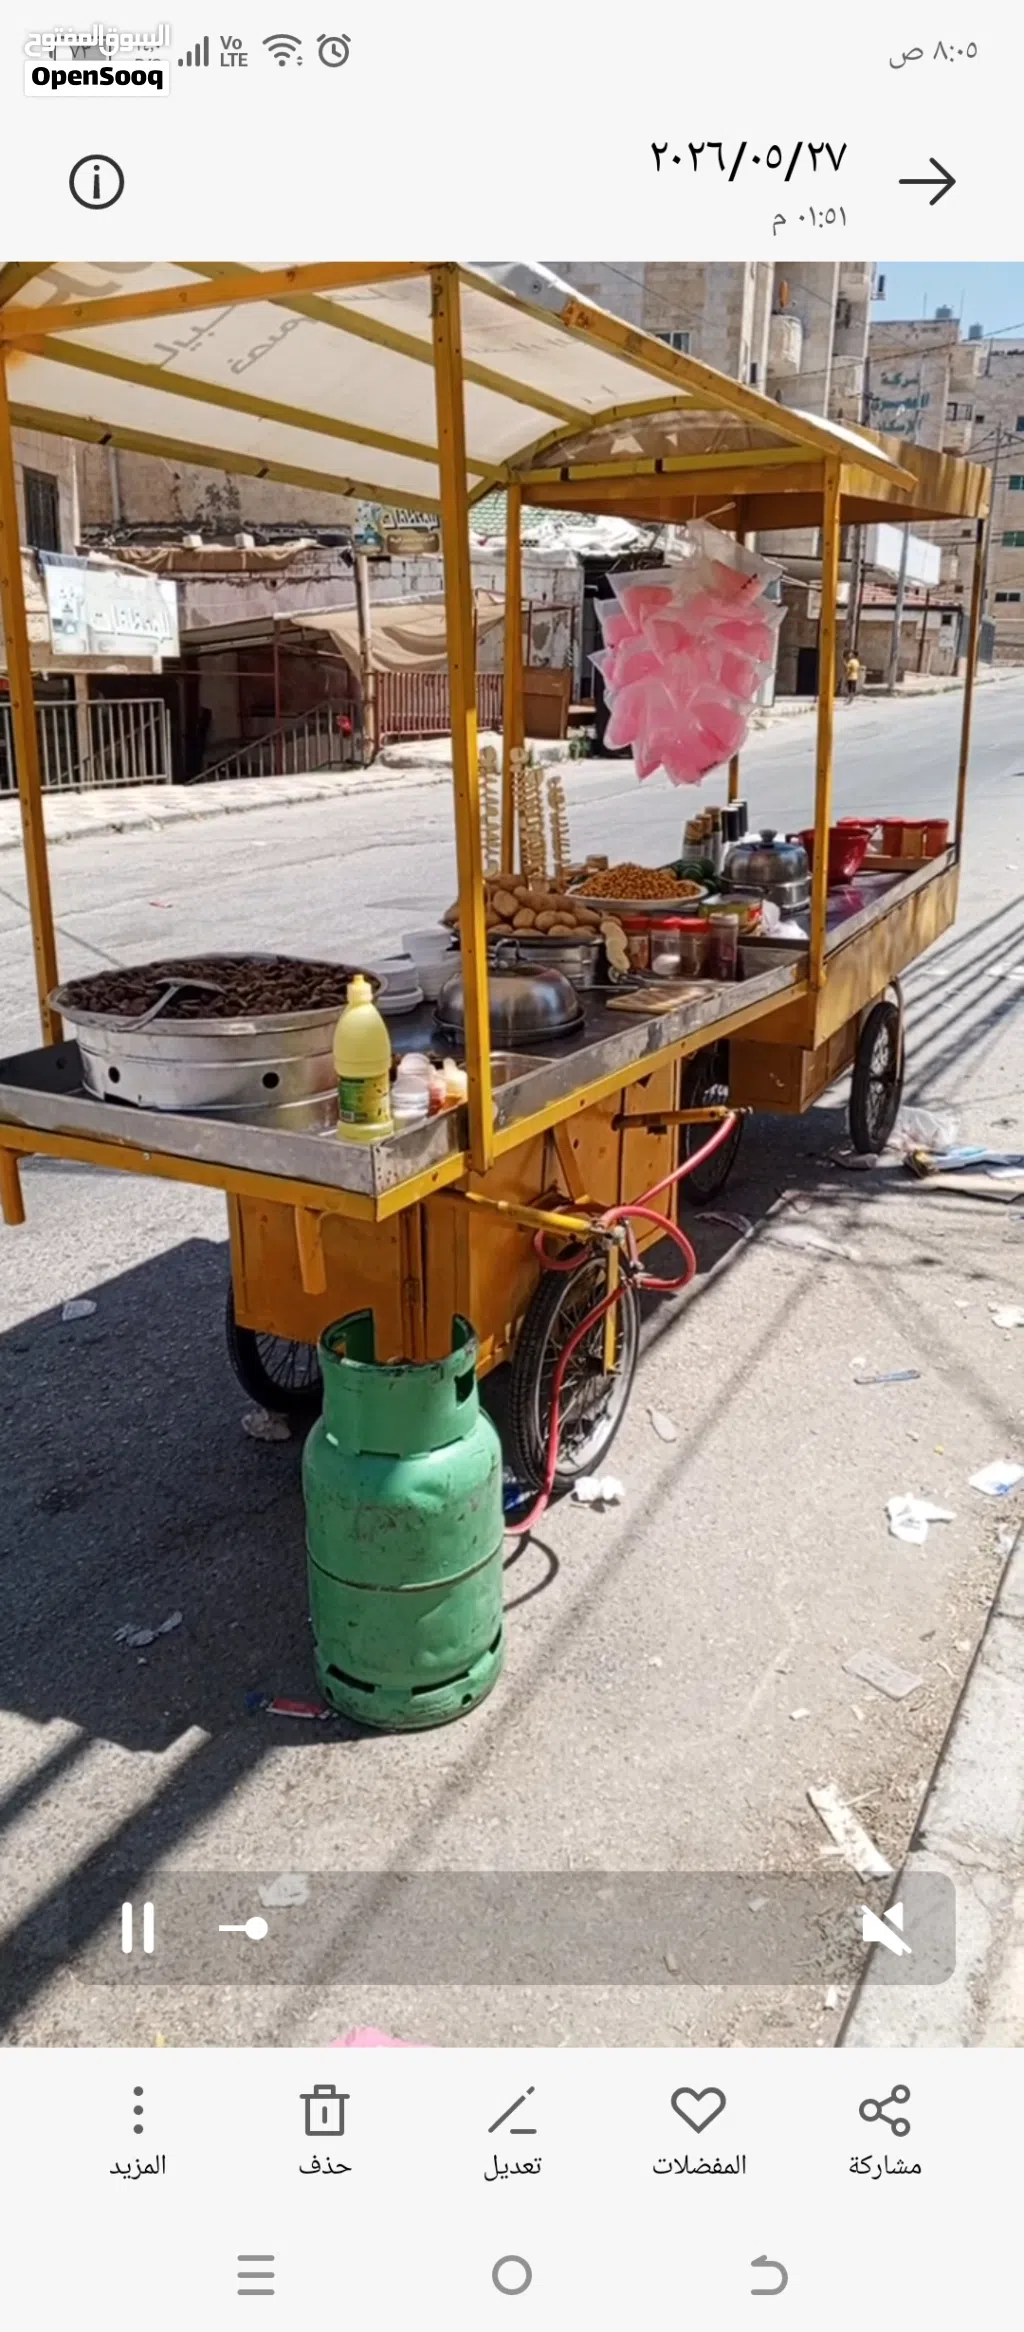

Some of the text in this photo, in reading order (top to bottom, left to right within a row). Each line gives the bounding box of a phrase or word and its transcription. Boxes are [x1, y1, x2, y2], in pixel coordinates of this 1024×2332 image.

[220, 36, 242, 49] Vo
[890, 41, 977, 69] ٨:٠٥ ص
[221, 53, 248, 67] LTE
[651, 141, 847, 182] ٢٠٢٦/٠٥/٢٧
[773, 207, 846, 236] ٠١:٥١ م
[110, 2155, 165, 2180] المزيد
[299, 2155, 352, 2174] حذف
[484, 2155, 542, 2181] تعديل
[653, 2155, 746, 2174] المفضلات
[849, 2155, 921, 2180] مشاركة
